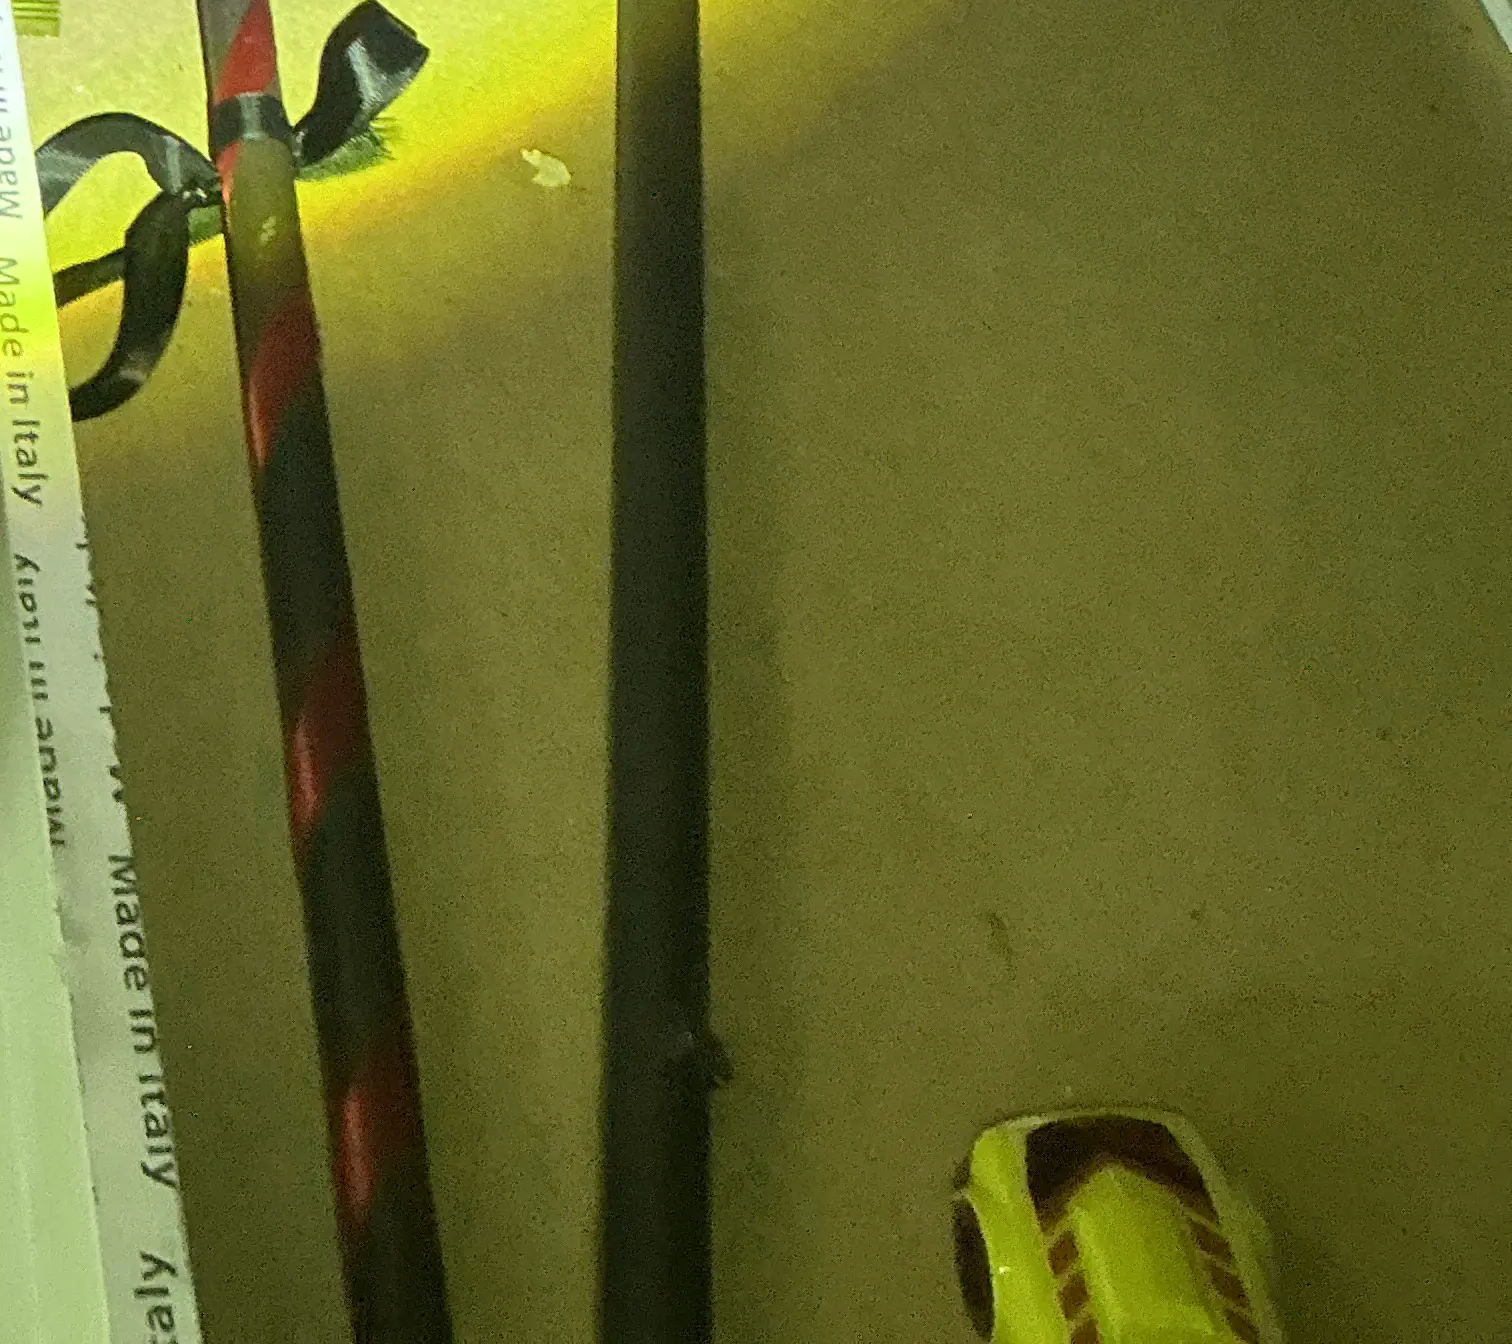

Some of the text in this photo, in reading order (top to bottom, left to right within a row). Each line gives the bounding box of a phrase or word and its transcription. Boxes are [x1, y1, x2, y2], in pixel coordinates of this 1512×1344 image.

[1, 370, 37, 405] in
[11, 419, 49, 508] Italy
[131, 1250, 179, 1344] aly
